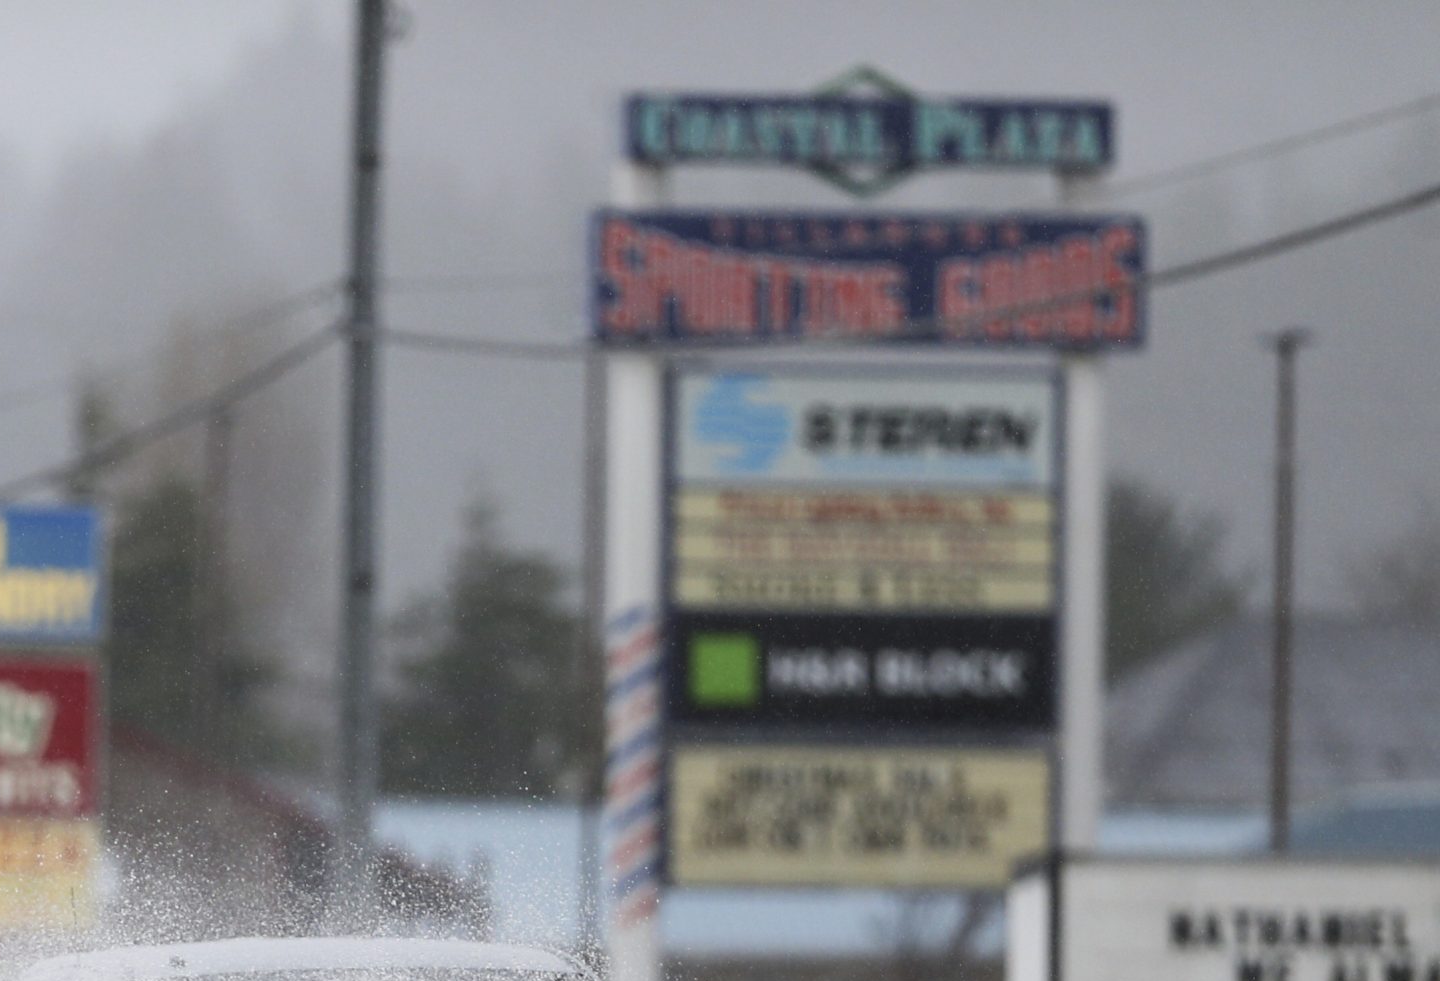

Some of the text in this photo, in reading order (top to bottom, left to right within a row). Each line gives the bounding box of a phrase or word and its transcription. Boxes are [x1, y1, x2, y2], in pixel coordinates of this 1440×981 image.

[639, 97, 1104, 161] COASTAL PLAZA
[600, 216, 1137, 341] SPORTING GOODS
[803, 406, 1038, 453] STEREN
[767, 648, 1026, 694] H&R BLOCK
[1169, 909, 1410, 948] NATHANIEL
